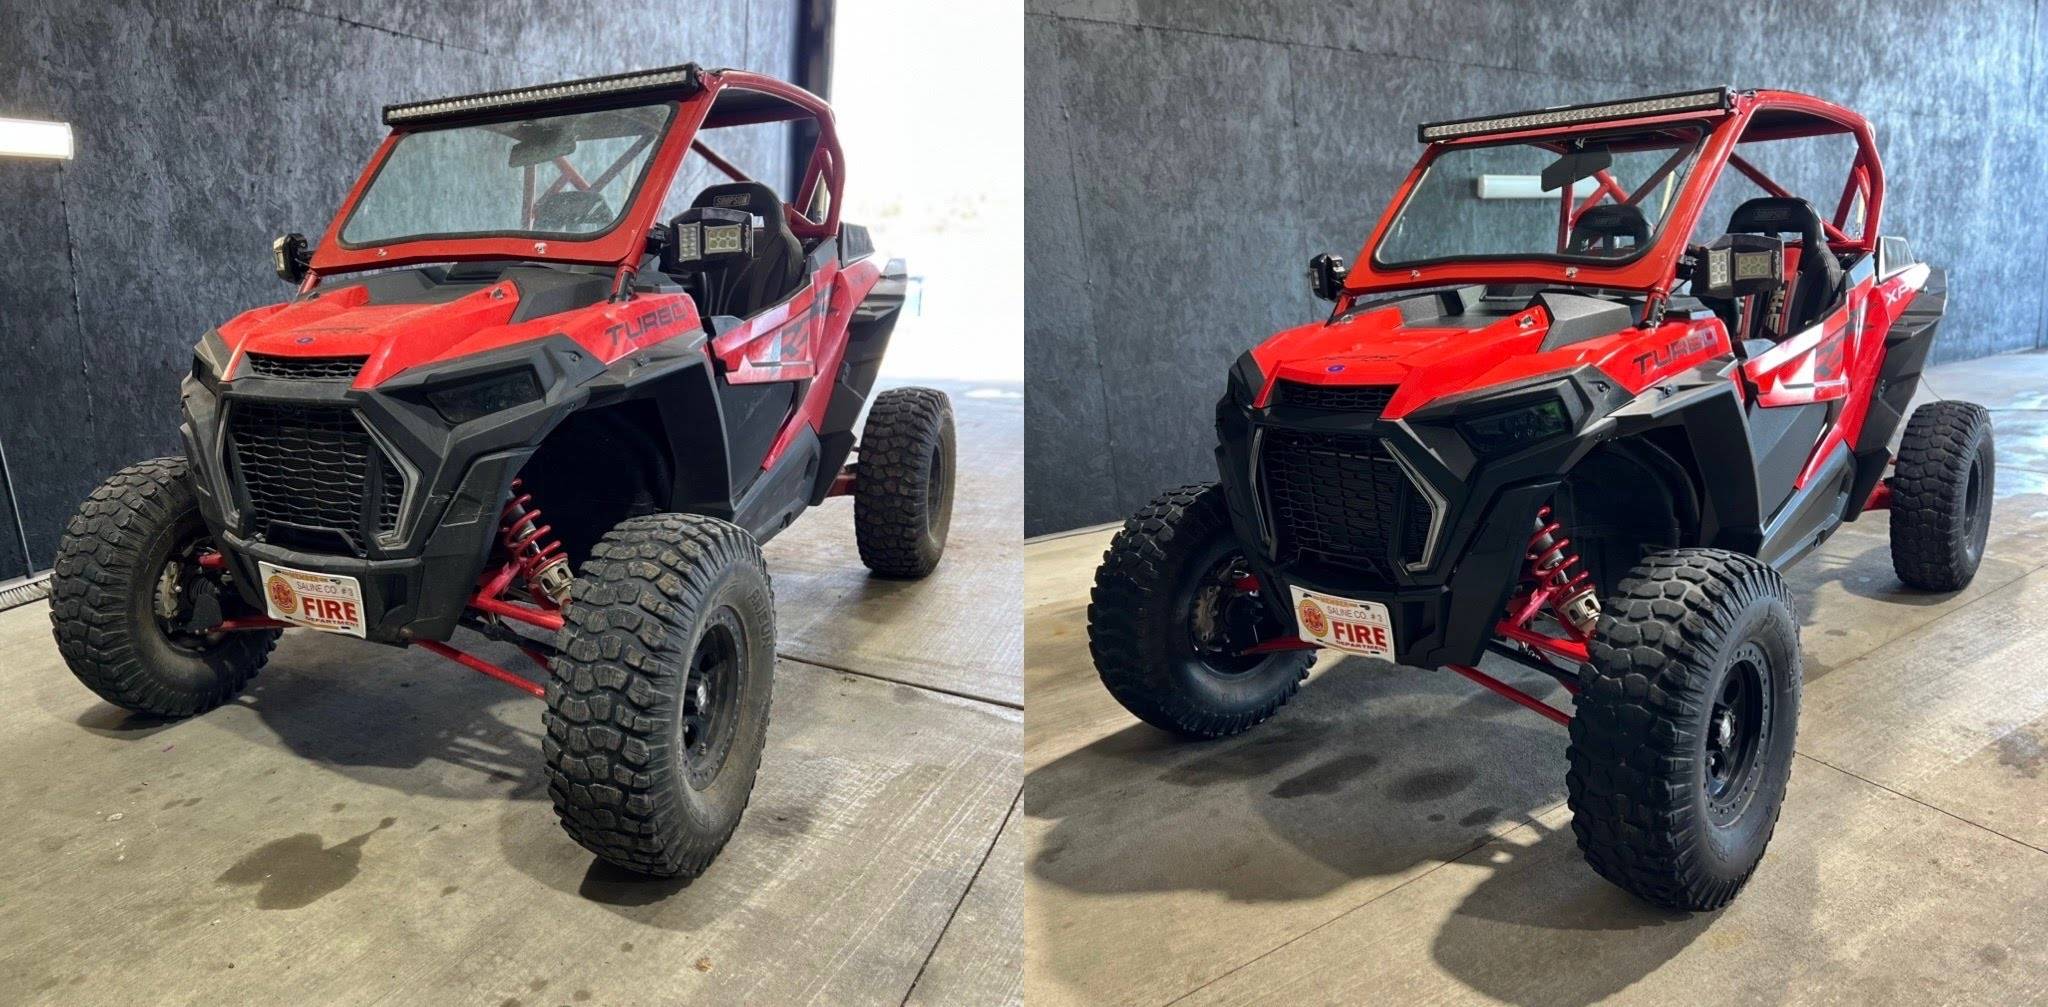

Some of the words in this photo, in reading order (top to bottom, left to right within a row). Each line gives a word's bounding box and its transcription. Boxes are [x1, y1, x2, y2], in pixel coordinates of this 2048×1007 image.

[605, 302, 688, 346] TURBO
[1632, 325, 1718, 376] TURBO
[297, 582, 322, 593] SALINE
[302, 597, 358, 622] FIRE
[1327, 606, 1352, 617] SALINE
[305, 616, 359, 627] DEPARTMENT
[1332, 621, 1387, 647] FIRE
[1336, 640, 1388, 653] DEPARTMENT
